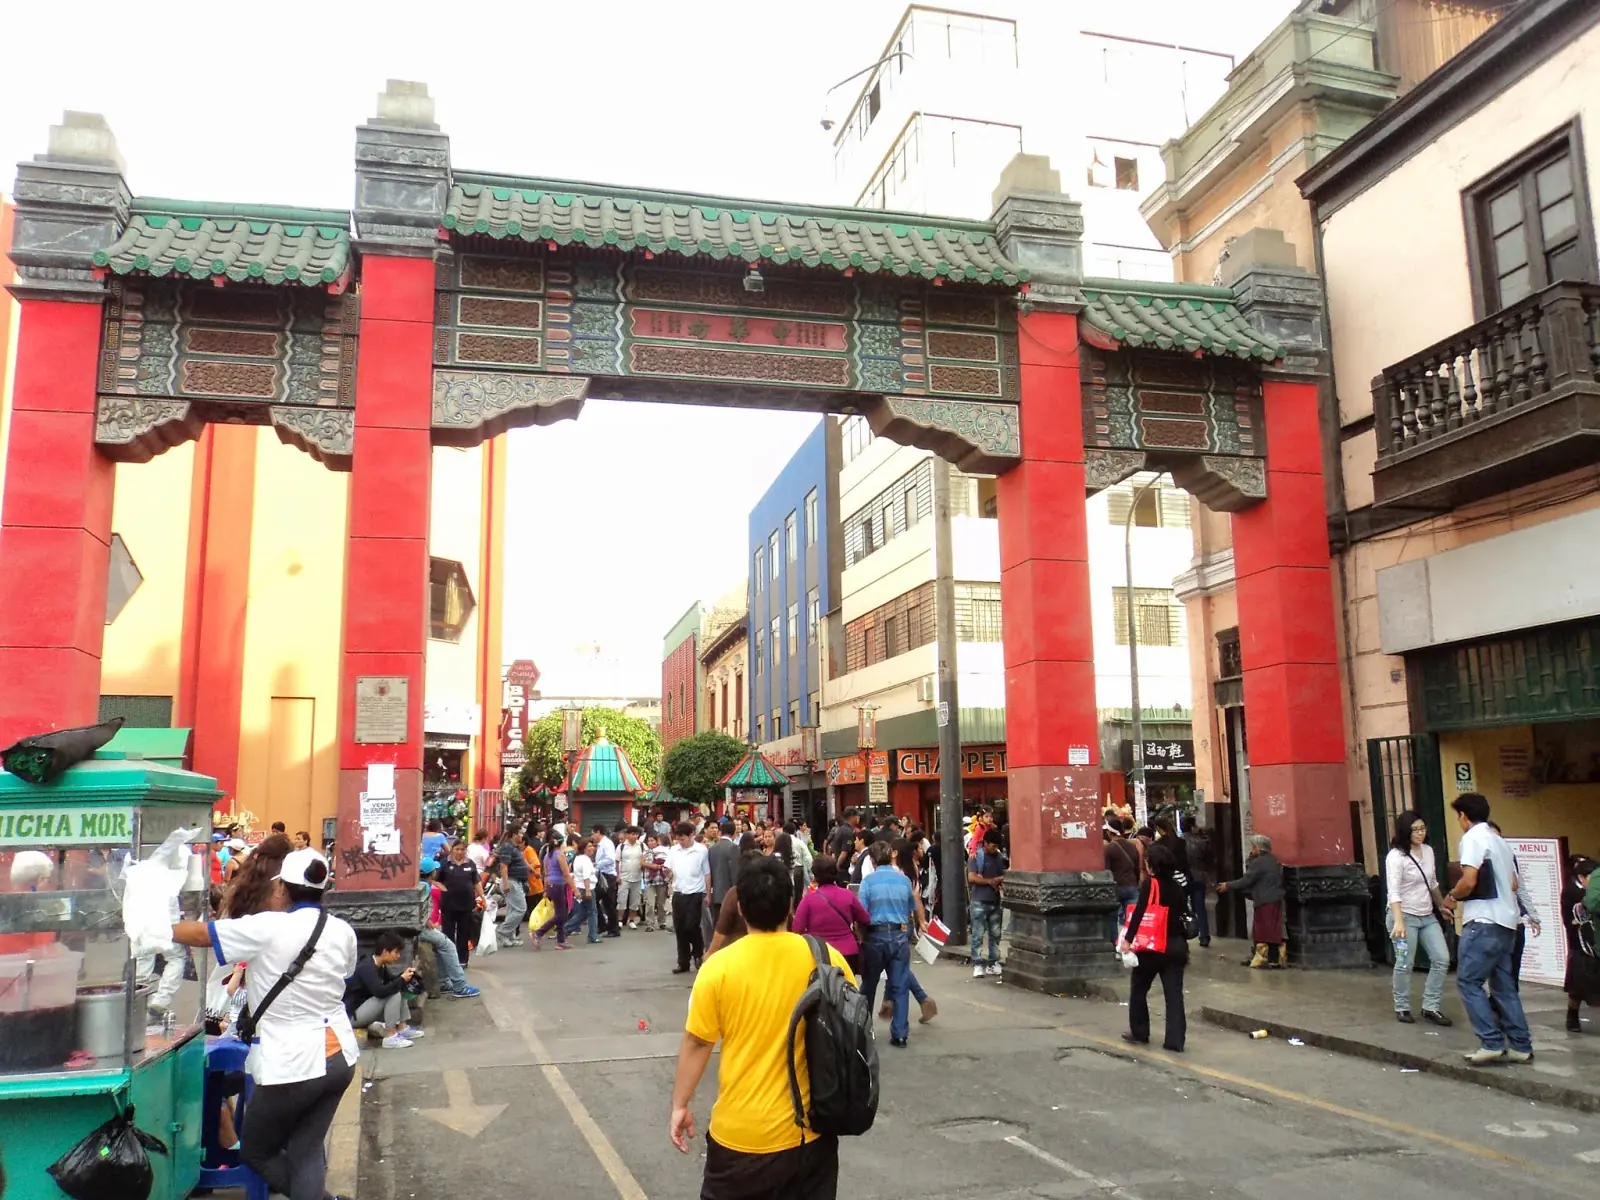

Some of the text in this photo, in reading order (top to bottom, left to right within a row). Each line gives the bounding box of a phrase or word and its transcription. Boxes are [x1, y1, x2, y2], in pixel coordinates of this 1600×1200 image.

[506, 685, 525, 751] BOTICA
[1457, 764, 1469, 780] S
[1519, 844, 1548, 853] MENU
